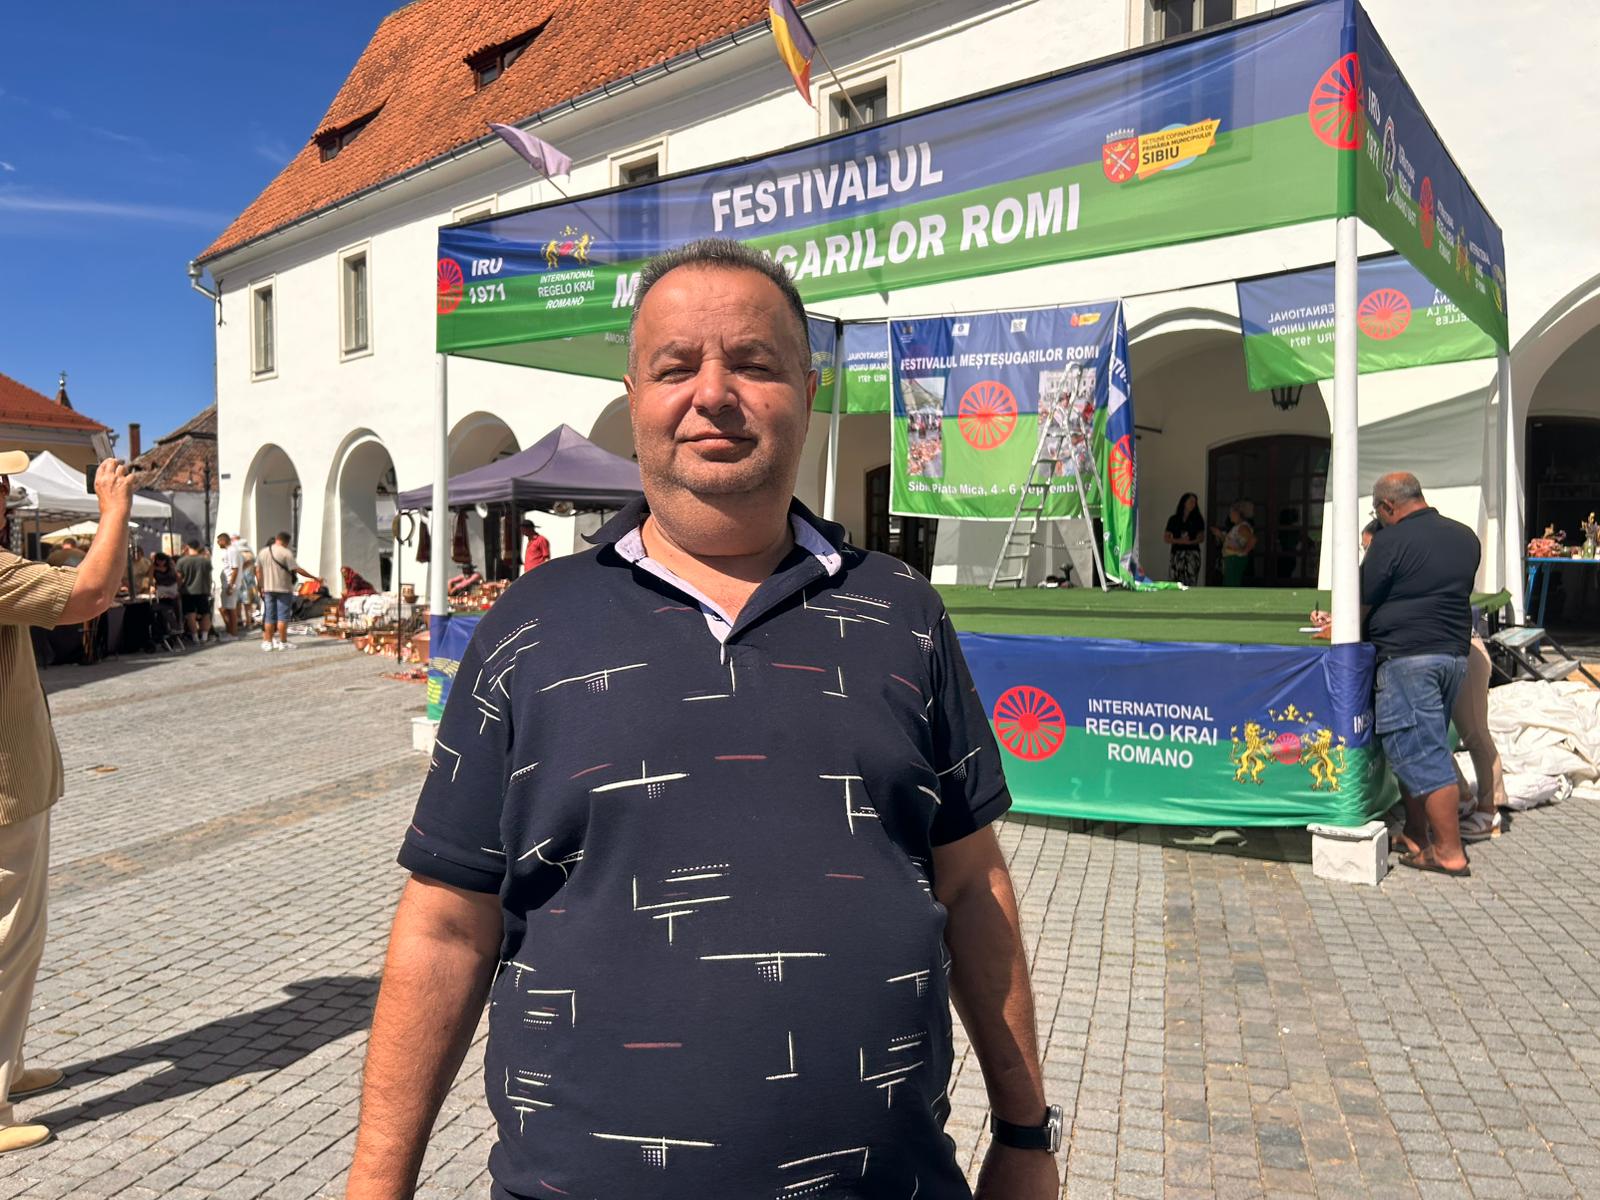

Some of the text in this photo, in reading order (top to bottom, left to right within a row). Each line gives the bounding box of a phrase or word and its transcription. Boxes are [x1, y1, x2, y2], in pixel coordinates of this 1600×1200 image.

[1368, 86, 1380, 126] IRU
[1142, 146, 1180, 165] SIBIU
[711, 142, 943, 232] FESTIVALUL
[959, 183, 1081, 251] ROMI
[471, 257, 504, 276] IRU
[540, 269, 595, 284] INTERNATIONAL
[469, 283, 506, 304] 1971
[537, 280, 596, 298] REGELO KRAI
[545, 296, 585, 310] ROMANO
[900, 355, 957, 371] FESTIVALUL
[1066, 345, 1099, 361] ROMI
[990, 484, 998, 495] 4
[1008, 484, 1016, 495] 6
[1088, 698, 1214, 722] INTERNATIONAL
[1085, 717, 1218, 746] REGELO KRAI
[1107, 743, 1194, 768] ROMANO
